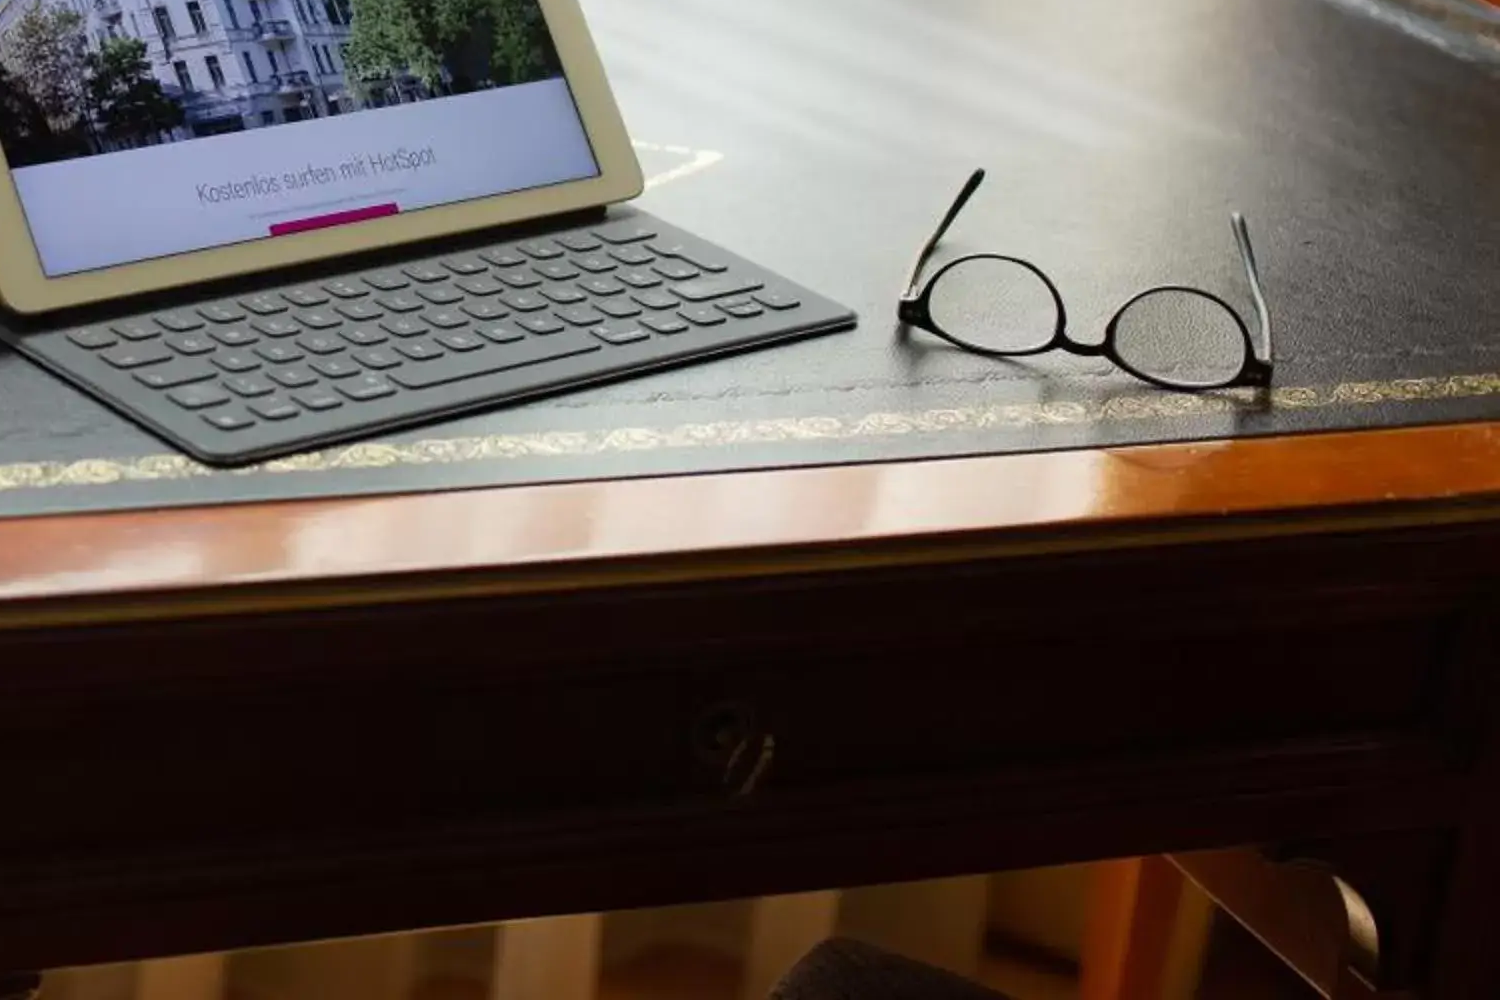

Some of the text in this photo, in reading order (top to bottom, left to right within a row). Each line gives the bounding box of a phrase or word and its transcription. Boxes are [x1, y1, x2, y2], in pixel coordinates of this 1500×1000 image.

[196, 177, 281, 203] Kostenlos
[283, 164, 337, 188] surfen
[339, 157, 367, 180] mit
[369, 146, 437, 173] HotSpot
